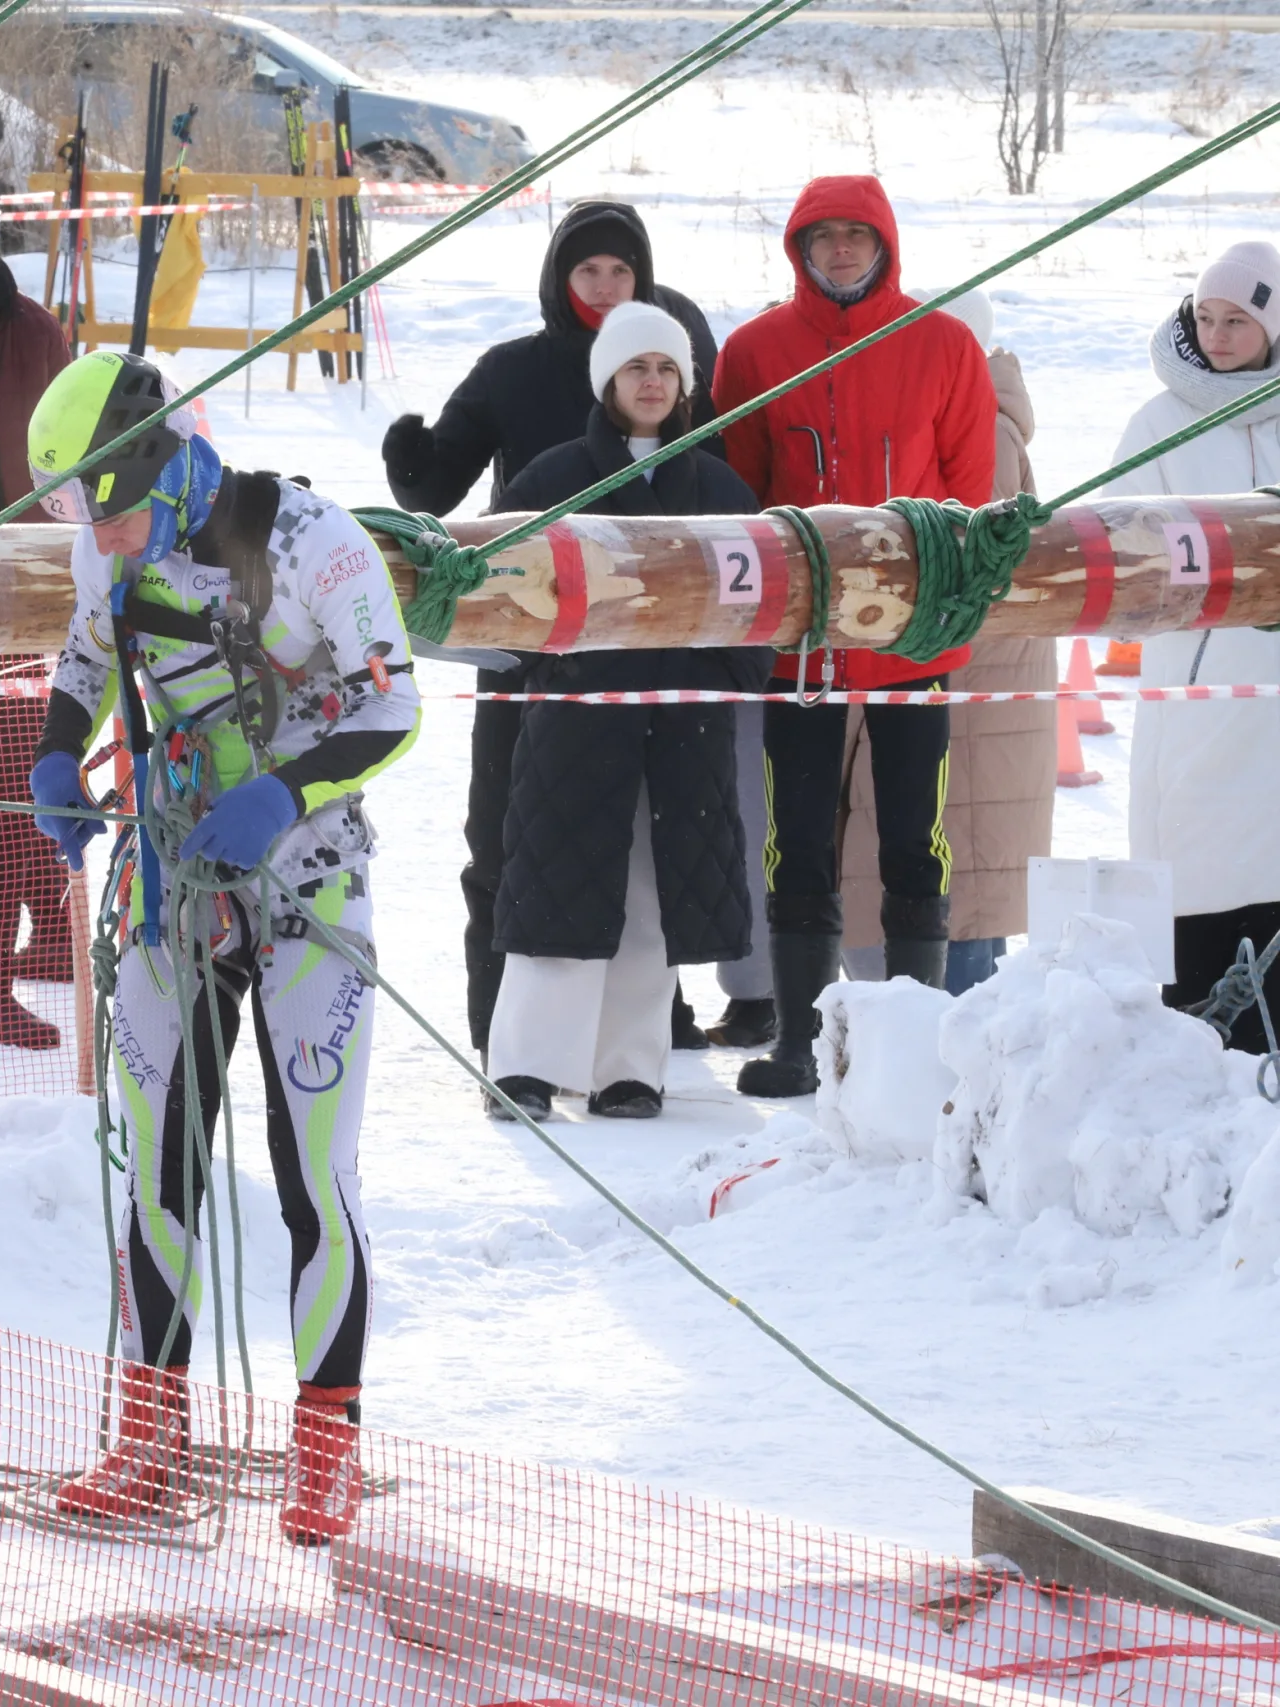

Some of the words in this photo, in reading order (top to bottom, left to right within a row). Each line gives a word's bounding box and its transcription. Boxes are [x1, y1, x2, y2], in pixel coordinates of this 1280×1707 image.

[1178, 342, 1208, 370] AHE
[47, 496, 66, 516] 22
[328, 542, 349, 561] VINI
[330, 548, 366, 576] PETTY
[1177, 534, 1200, 572] 1
[333, 560, 370, 586] ROSSO
[727, 552, 753, 592] 2
[327, 974, 353, 1018] TEAM
[328, 968, 364, 1050] FUTU
[115, 980, 163, 1084] RAFICHE
